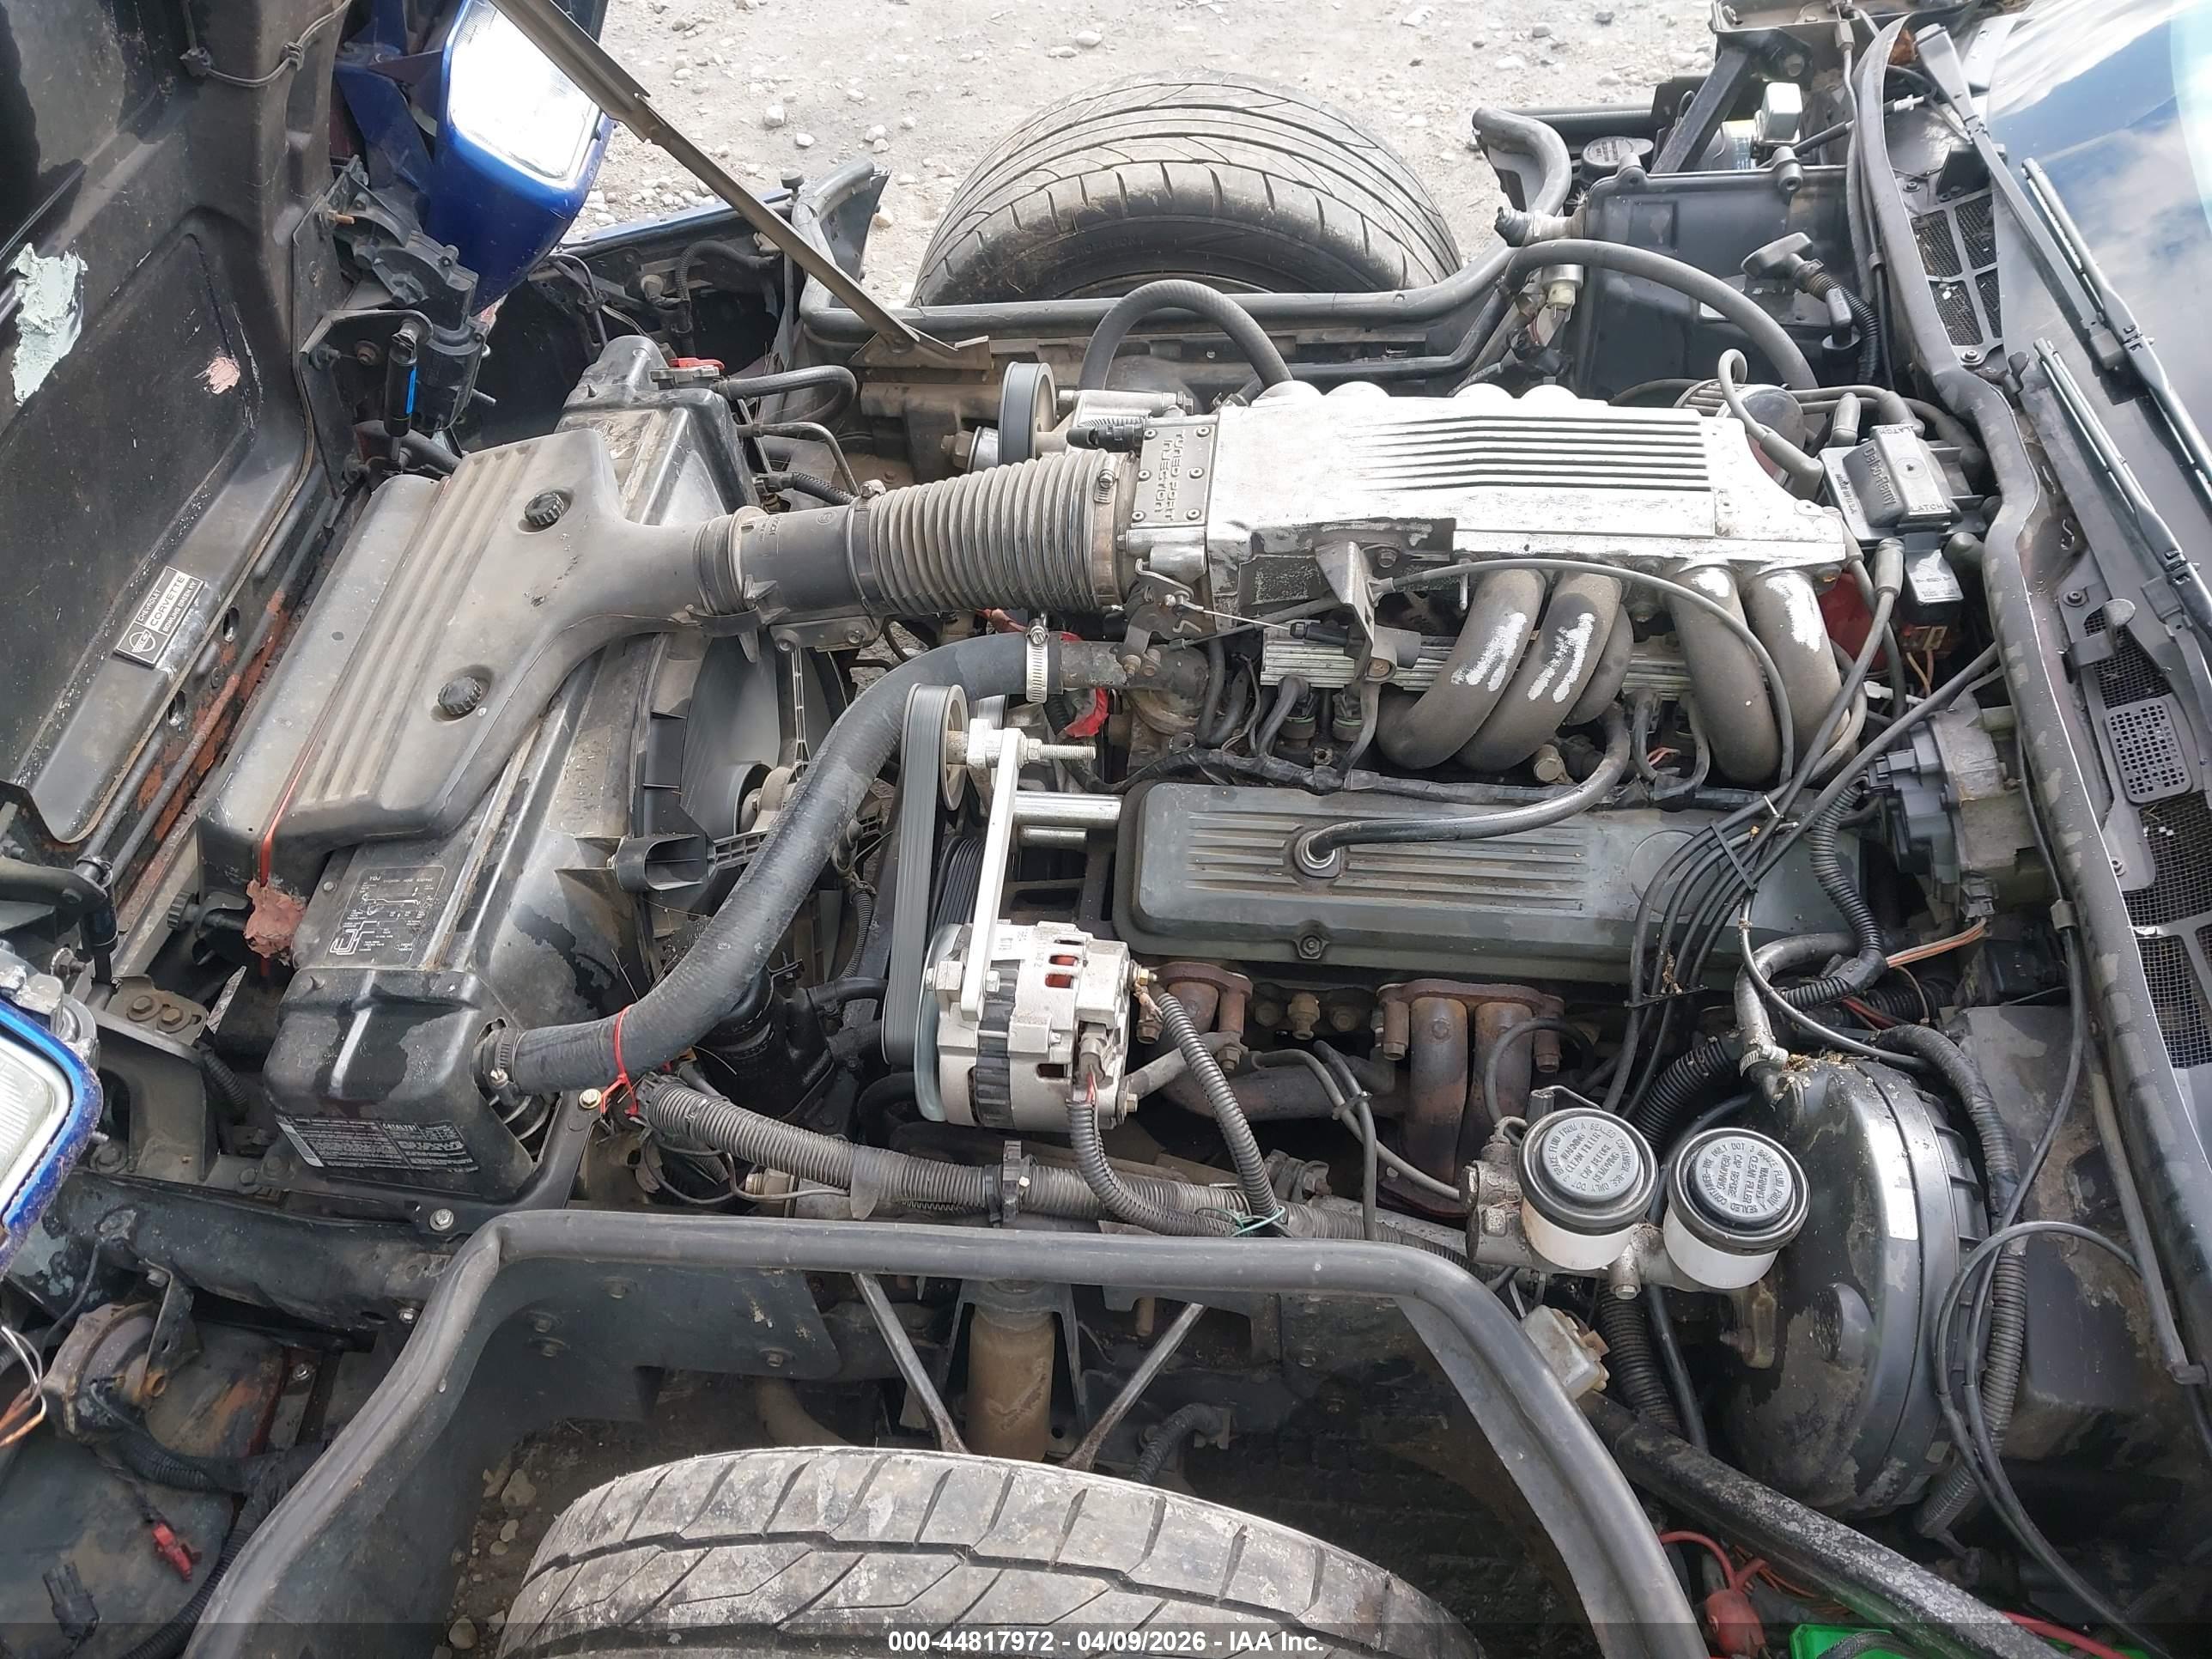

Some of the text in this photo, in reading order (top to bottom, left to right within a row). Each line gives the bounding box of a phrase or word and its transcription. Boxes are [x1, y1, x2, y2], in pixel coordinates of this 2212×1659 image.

[1165, 430, 1184, 521] TUNED PORT
[137, 588, 161, 622] CHEVROLET
[151, 576, 185, 627] CORVETTE
